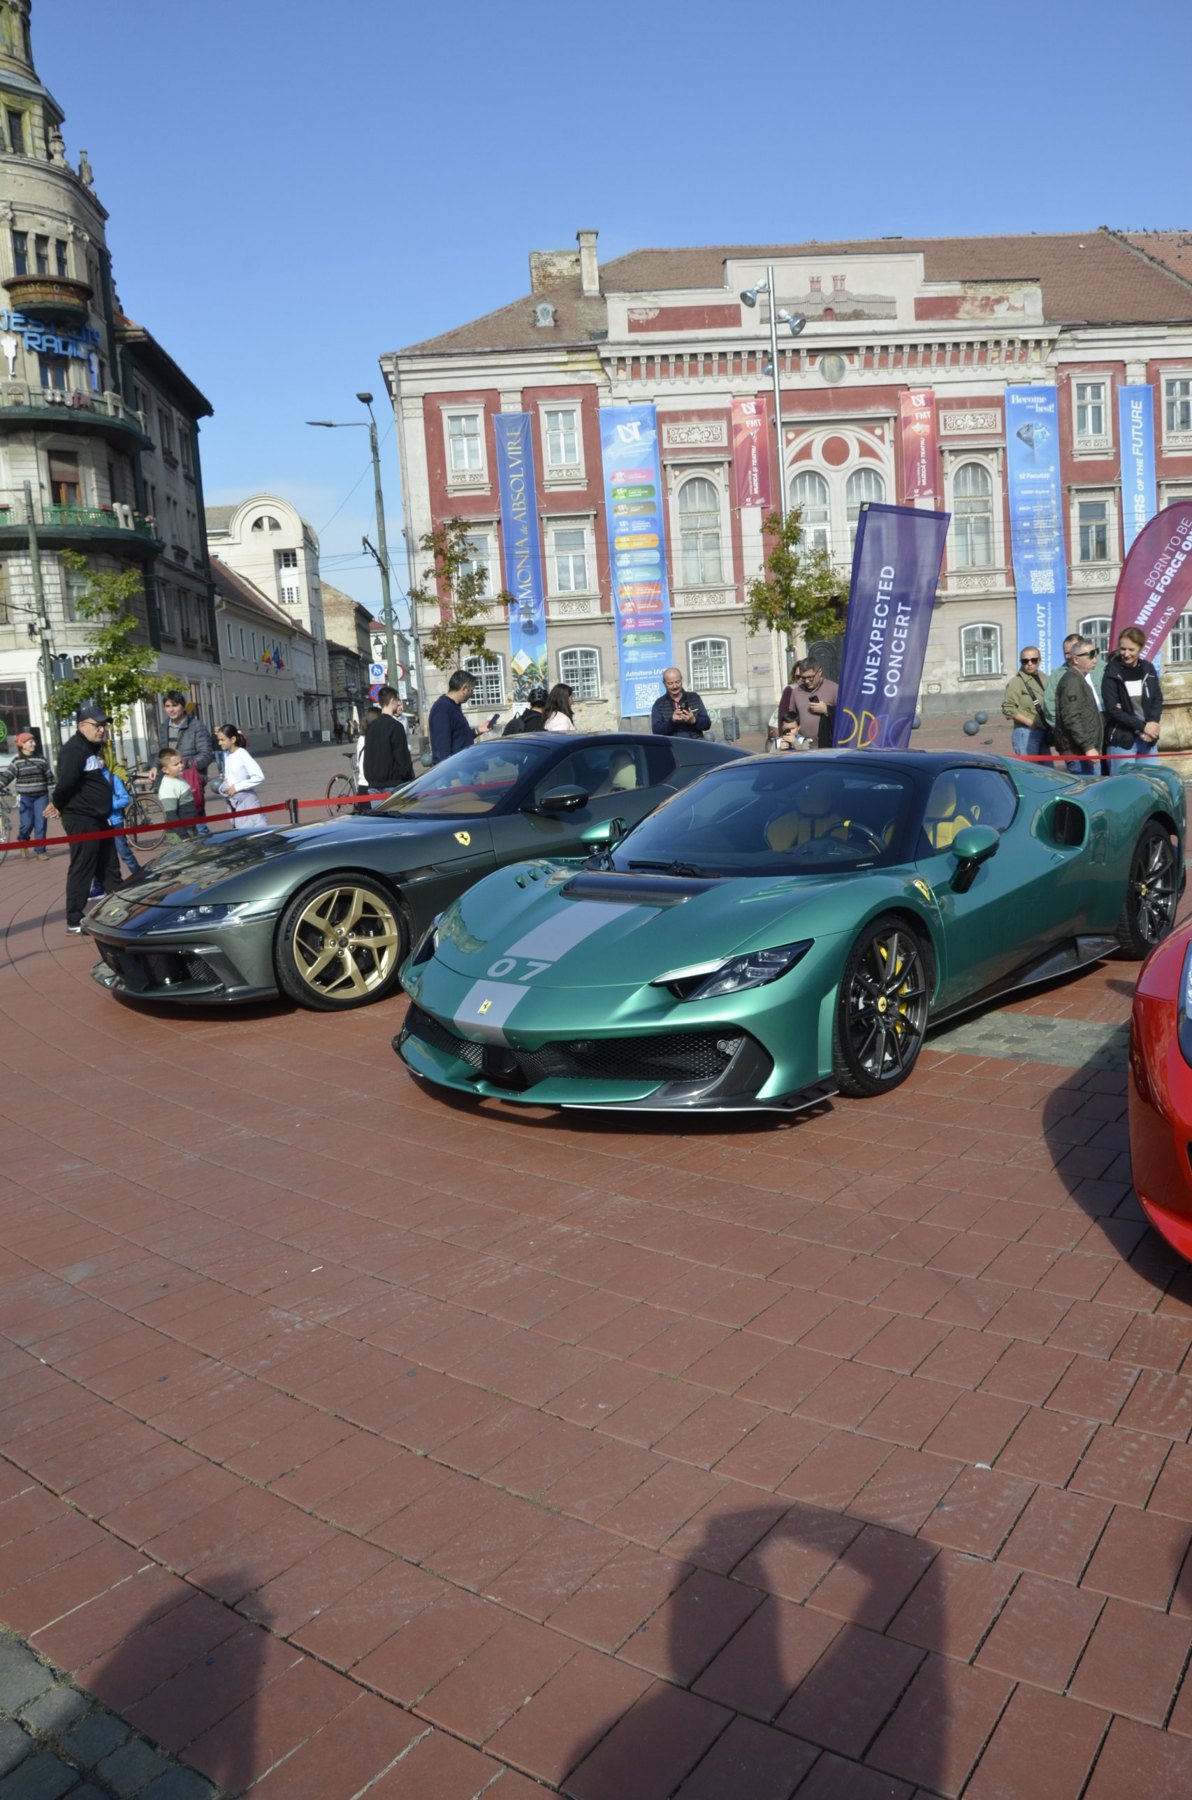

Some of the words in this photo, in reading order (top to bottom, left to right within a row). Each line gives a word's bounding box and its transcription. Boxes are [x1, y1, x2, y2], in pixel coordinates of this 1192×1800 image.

[745, 419, 761, 428] FMT
[914, 411, 931, 420] FMT
[1131, 400, 1144, 456] FUTURE
[506, 428, 528, 524] ABSOLVIRE
[1136, 458, 1144, 474] THE
[1137, 479, 1144, 491] OF
[1144, 553, 1172, 588] BORN
[1164, 537, 1182, 553] TO
[1176, 517, 1192, 536] BE
[1134, 592, 1162, 627] WINE
[1155, 552, 1187, 593] FORCE
[861, 565, 895, 696] UNEXPECTED
[1036, 603, 1046, 628] UVT
[884, 601, 912, 698] CONCERT
[487, 958, 552, 981] 07
